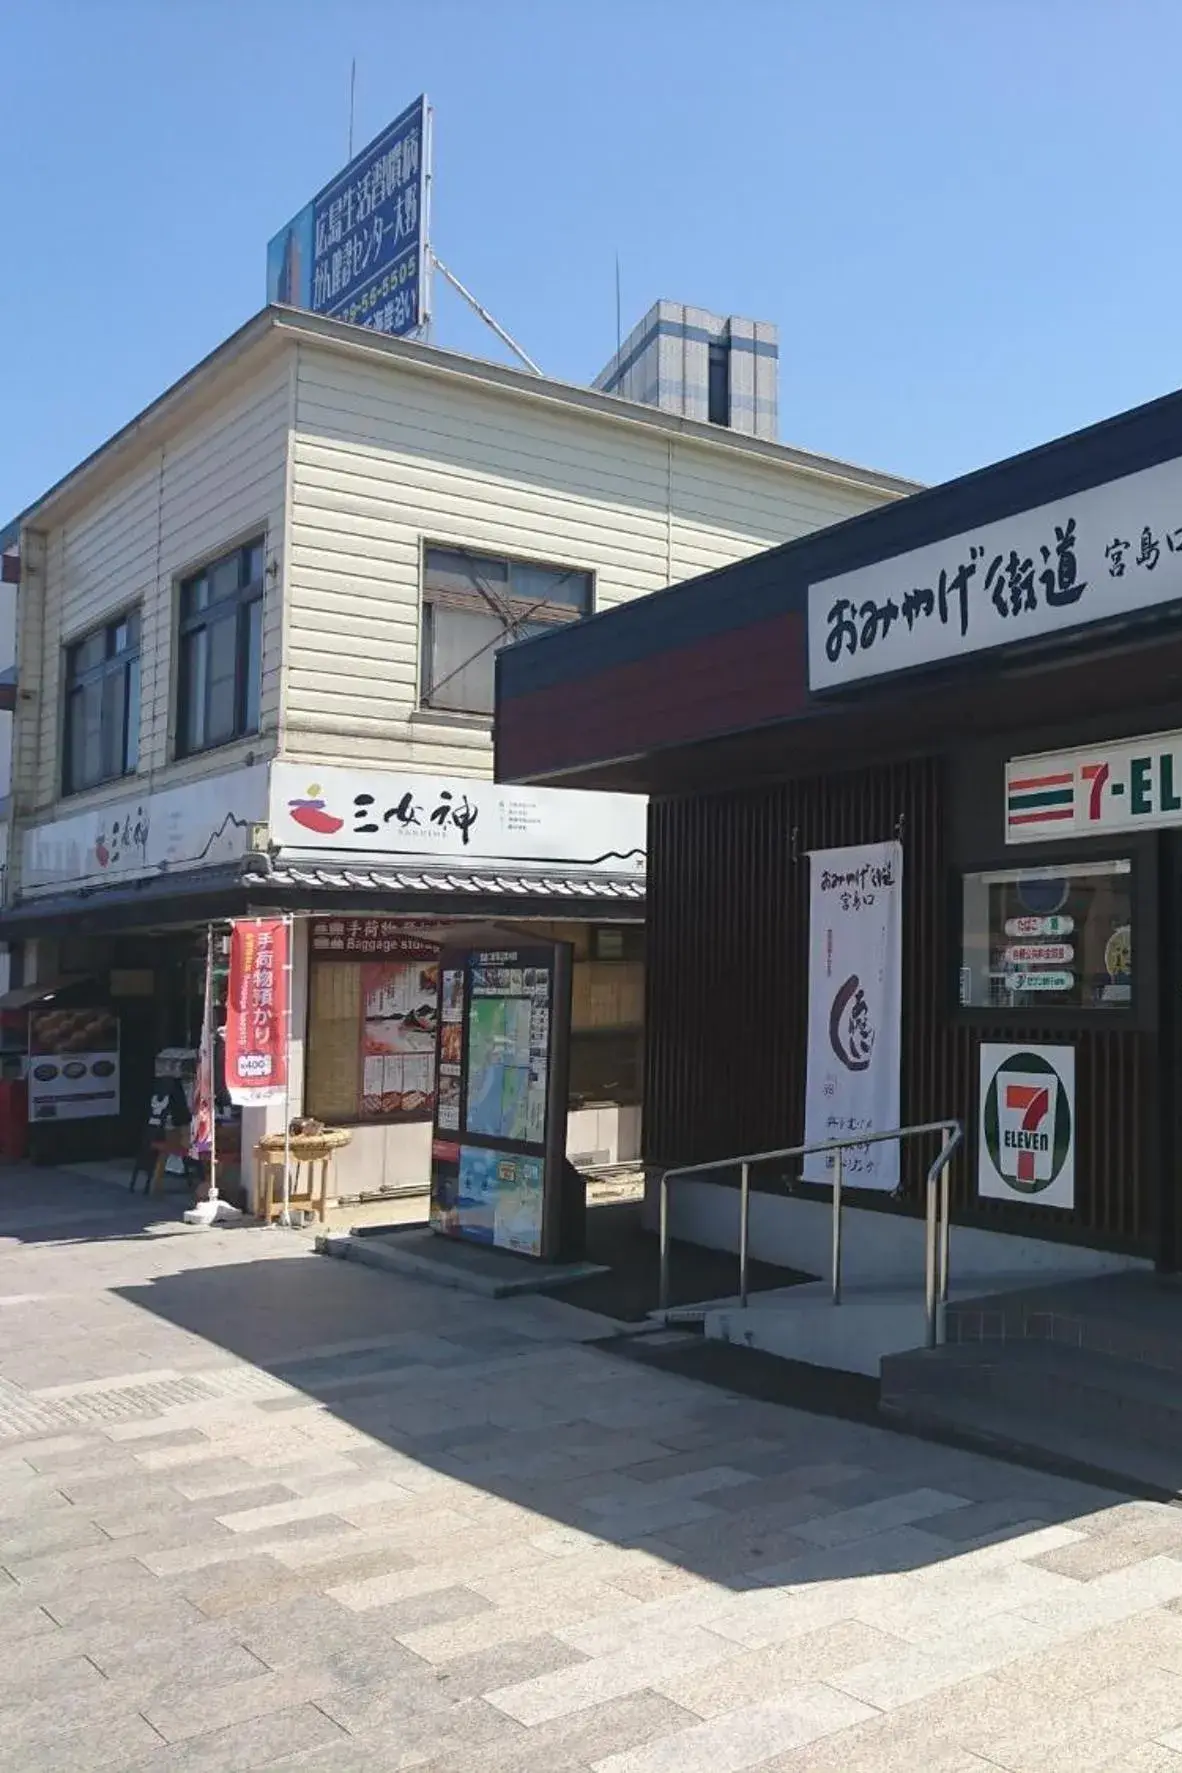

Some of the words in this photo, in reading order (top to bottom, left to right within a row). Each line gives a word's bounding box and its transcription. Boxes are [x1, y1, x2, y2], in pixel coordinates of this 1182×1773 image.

[825, 517, 1087, 663] おみやげ街道
[252, 932, 274, 1045] 手荷物預かり
[1006, 1085, 1049, 1181] 7
